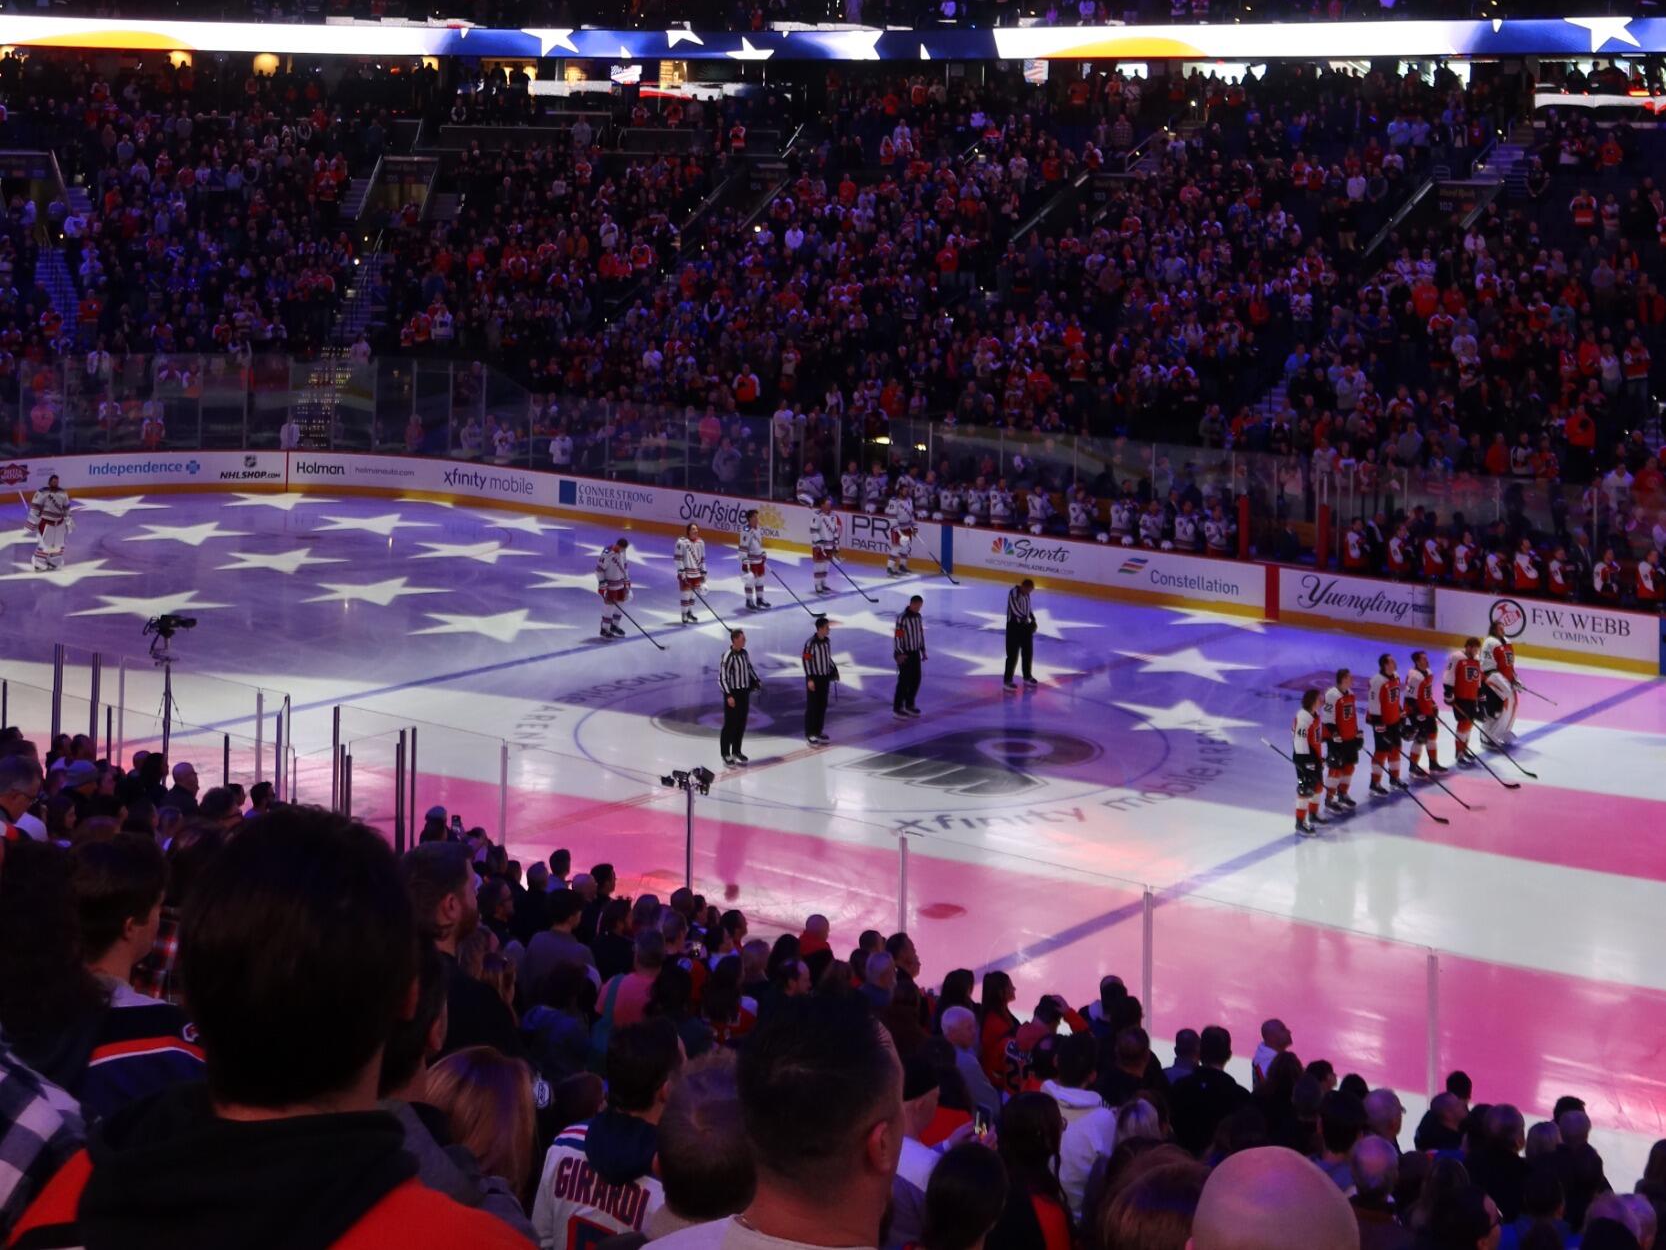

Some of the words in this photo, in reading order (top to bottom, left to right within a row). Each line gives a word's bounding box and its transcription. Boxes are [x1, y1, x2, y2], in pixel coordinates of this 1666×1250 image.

[88, 461, 183, 477] Independence
[219, 471, 282, 480] NHLSHOP.COM
[296, 461, 346, 476] Holman
[443, 468, 487, 491] xfinity
[489, 476, 534, 495] mobile
[578, 484, 615, 499] CONNER
[616, 489, 654, 504] STRONG
[578, 495, 585, 505] &
[586, 496, 633, 512] BUCKELEW
[680, 493, 749, 525] Surfside
[851, 538, 892, 553] PARTN
[1014, 539, 1071, 563] Sports
[1149, 569, 1240, 596] Constellation
[1297, 574, 1412, 623] Yuengling
[1570, 613, 1632, 638] WEBB
[1552, 631, 1607, 647] COMPANY
[892, 804, 1088, 838] xfinity
[1101, 764, 1224, 813] mobile
[554, 1156, 651, 1232] GIRARDI
